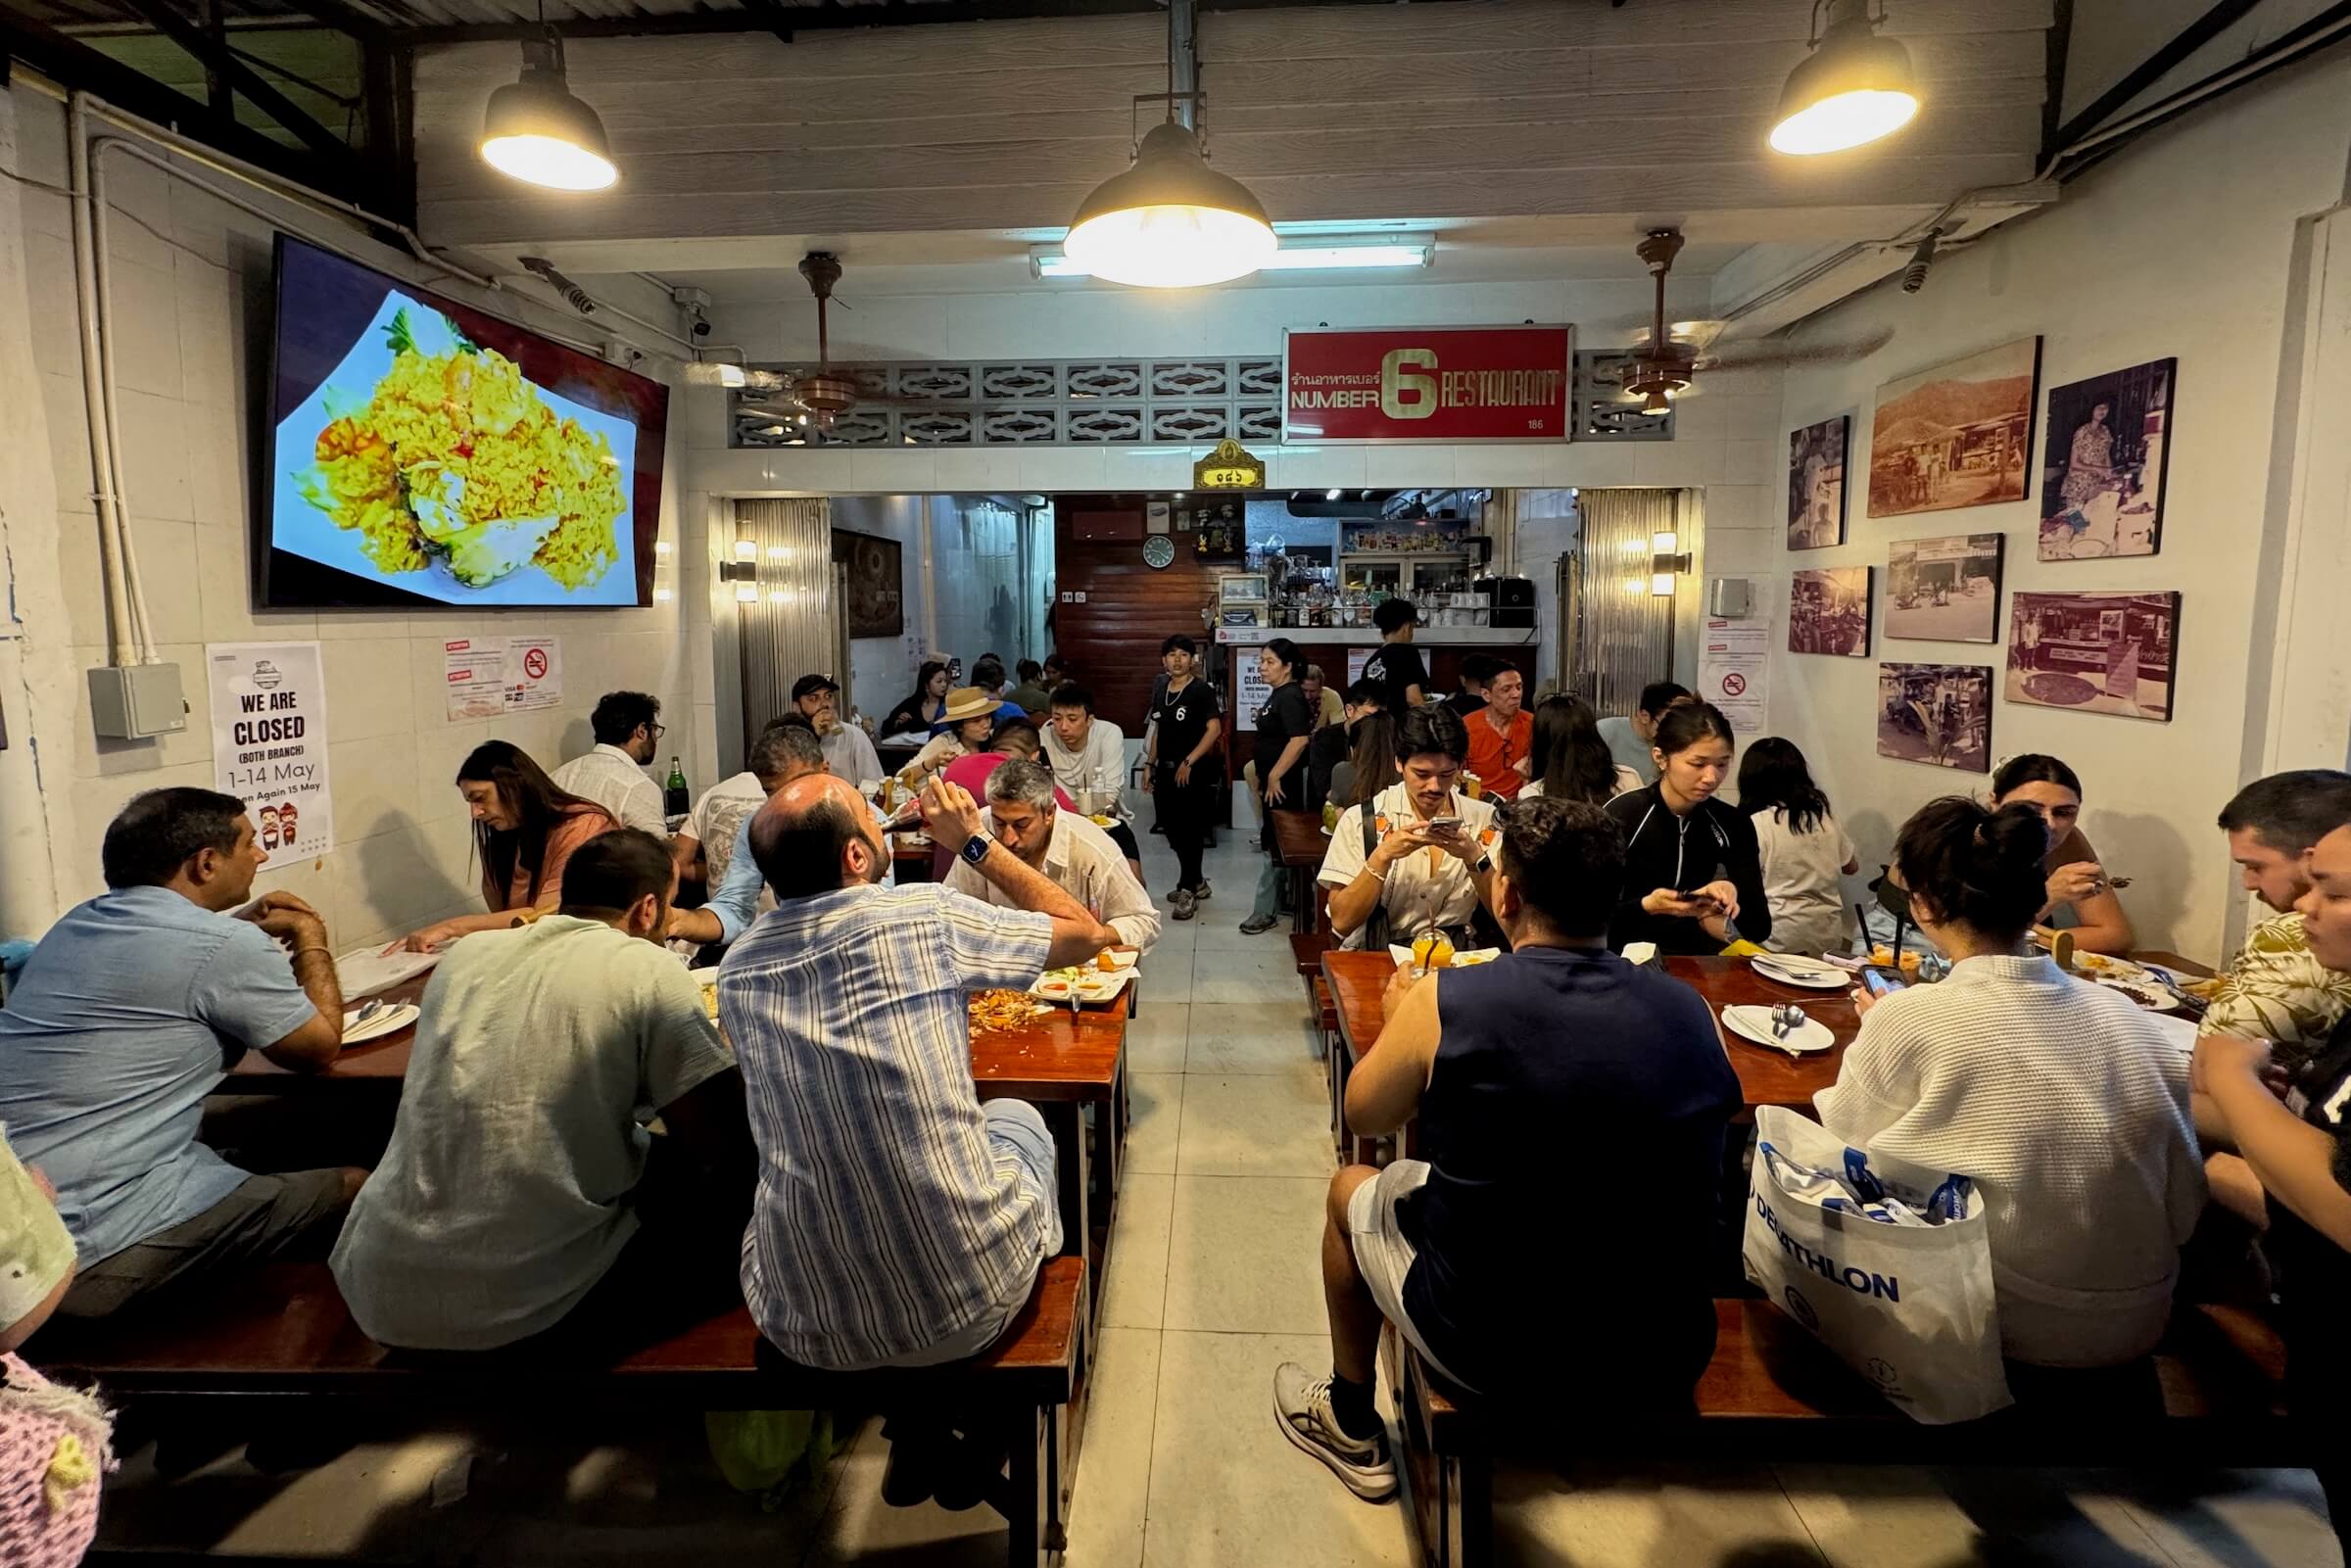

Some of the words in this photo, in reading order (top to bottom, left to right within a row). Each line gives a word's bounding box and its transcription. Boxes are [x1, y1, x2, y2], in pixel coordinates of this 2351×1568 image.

[1291, 390, 1380, 408] NUMBER
[1381, 348, 1439, 419] 6
[1441, 369, 1560, 407] RESTAURANT
[1528, 419, 1544, 429] 186
[241, 694, 264, 713] WE
[269, 691, 297, 711] ARE
[1176, 707, 1186, 721] 6
[234, 716, 305, 745] CLOSED
[239, 750, 264, 764] (BOTH
[267, 745, 305, 760] BRANCH)
[274, 763, 314, 782] May
[257, 788, 286, 801] Again
[288, 785, 298, 794] 15
[301, 783, 321, 792] May
